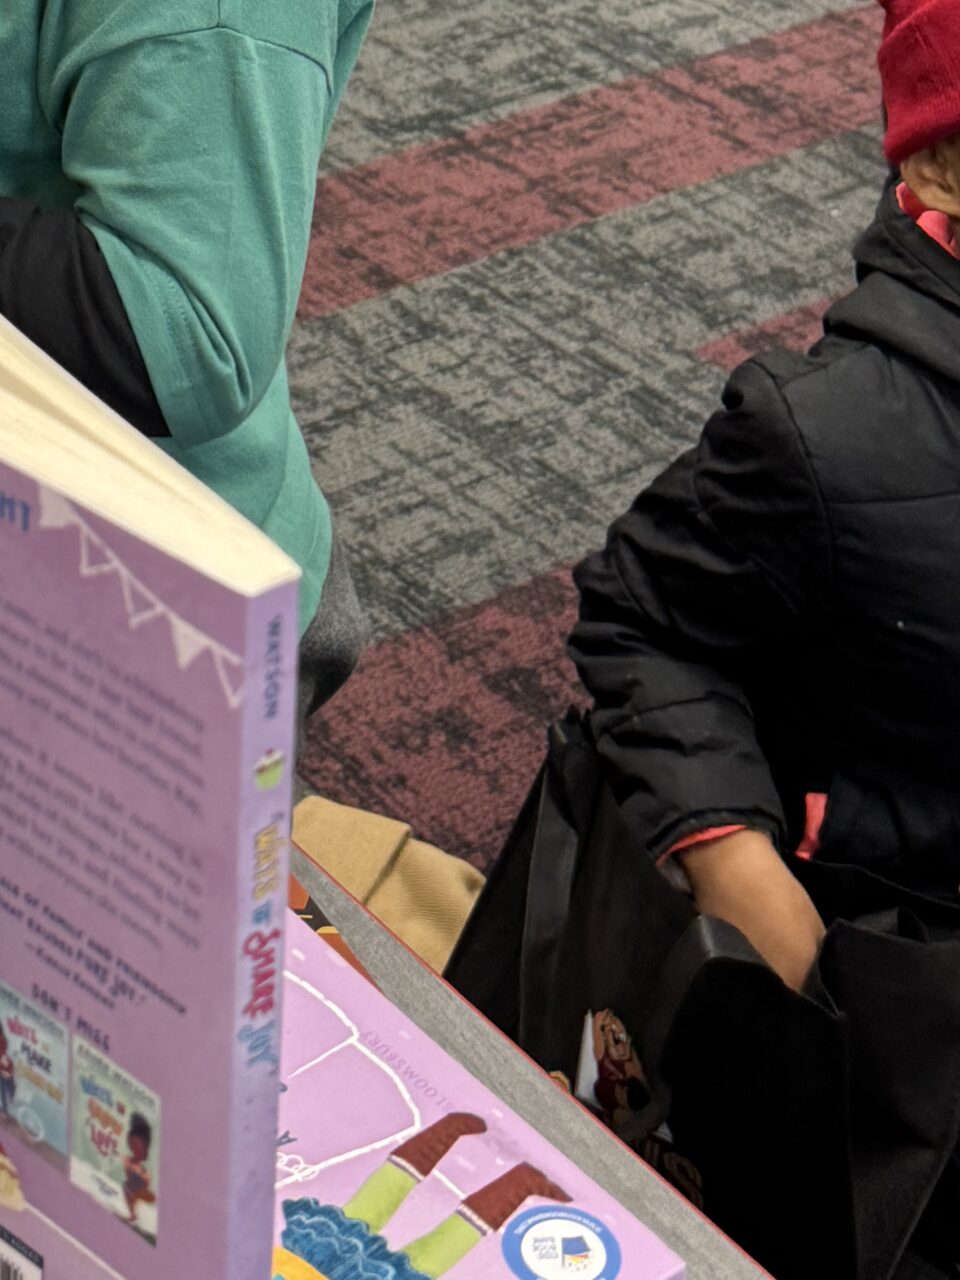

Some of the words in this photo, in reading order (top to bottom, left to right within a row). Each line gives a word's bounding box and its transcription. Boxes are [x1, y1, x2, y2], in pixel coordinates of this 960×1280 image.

[263, 613, 282, 720] WATSON
[23, 891, 39, 908] OF
[87, 938, 113, 961] AND
[75, 949, 110, 984] PURE
[242, 927, 282, 1019] SHARE
[76, 1016, 111, 1052] MISS
[238, 1019, 279, 1069] JOY
